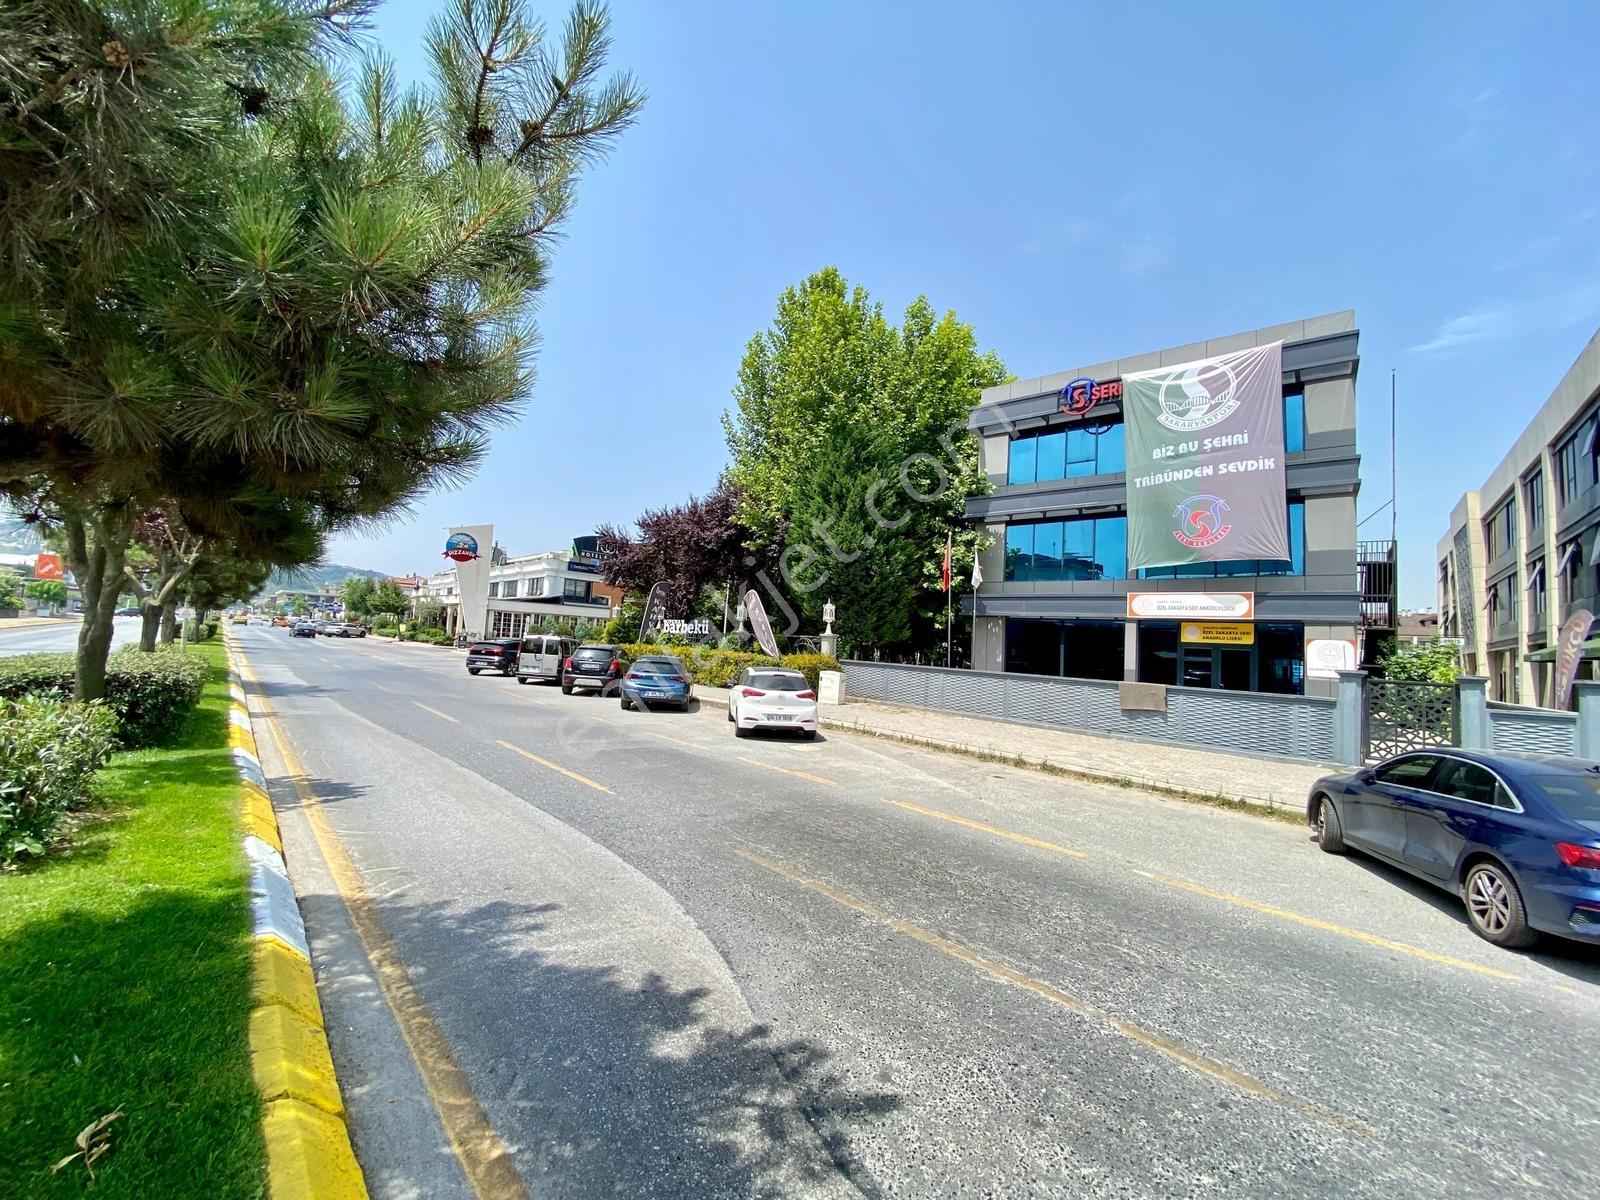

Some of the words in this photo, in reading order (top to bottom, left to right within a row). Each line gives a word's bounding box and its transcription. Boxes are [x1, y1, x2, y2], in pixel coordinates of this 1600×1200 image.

[1162, 403, 1234, 428] SAKARYASPOR
[1152, 444, 1175, 459] BİZ
[1178, 440, 1199, 454] BU
[1203, 430, 1249, 452] ŞEHRİ
[1134, 466, 1213, 489] TRİBÜNDEN
[1218, 455, 1276, 475] SEVDİK
[663, 619, 709, 635] barbekü
